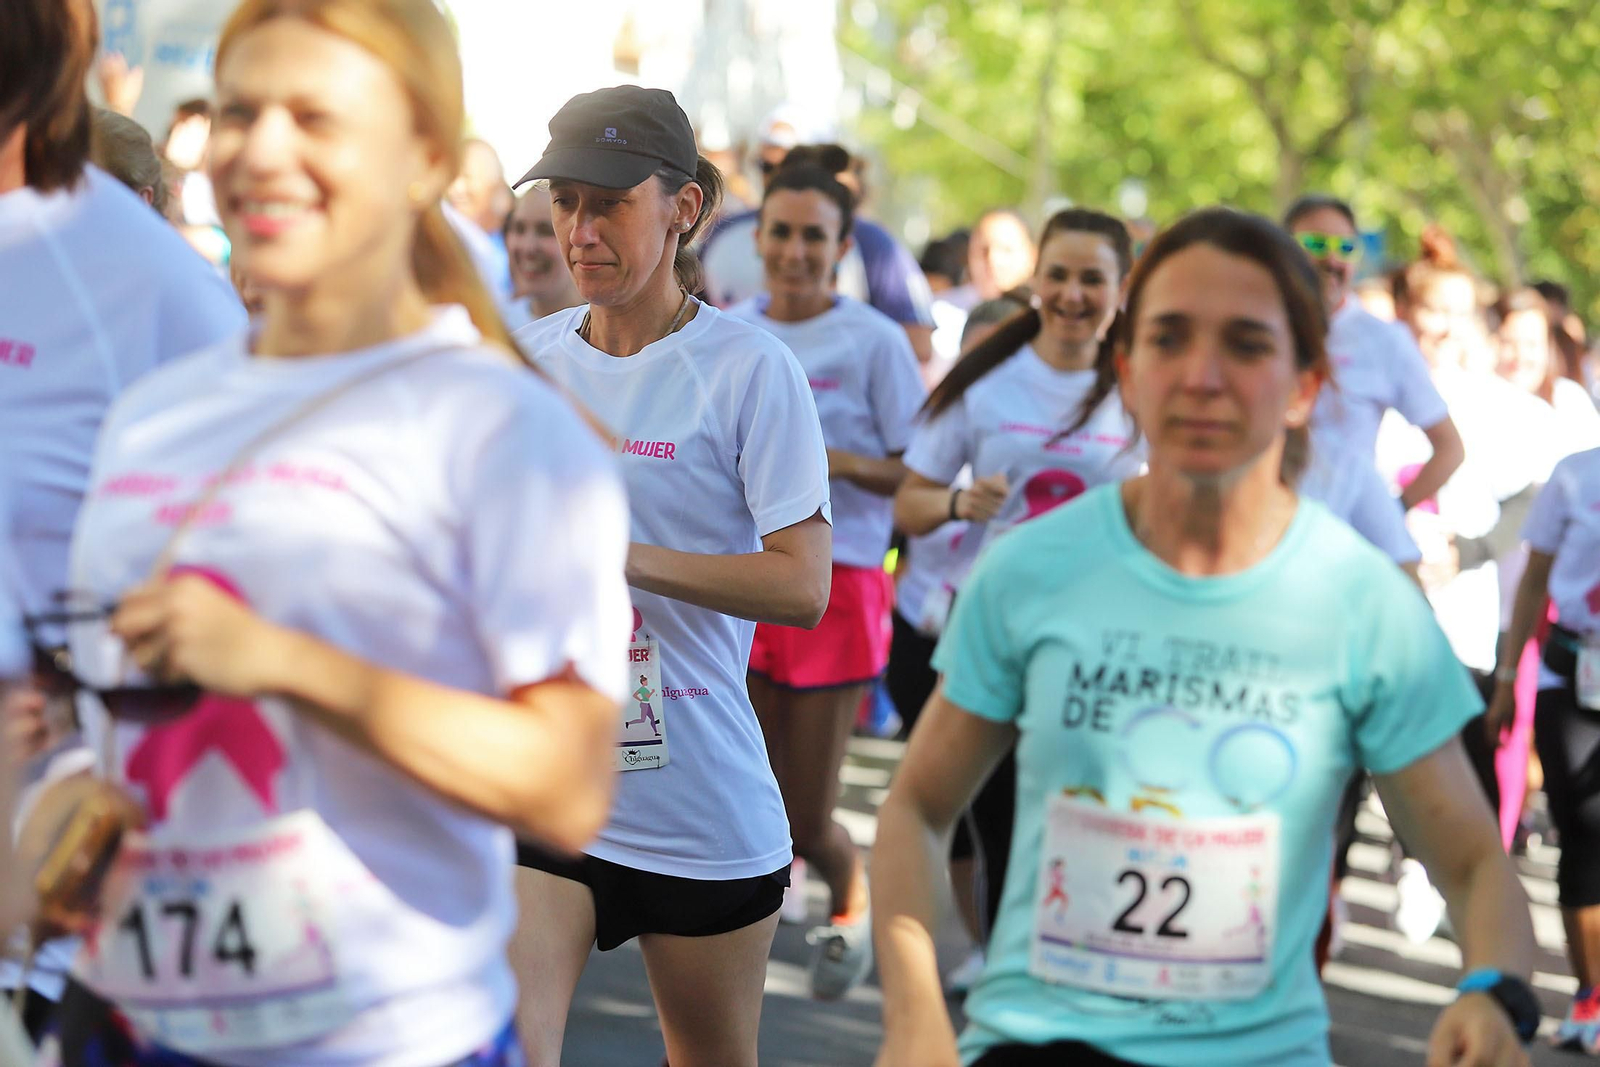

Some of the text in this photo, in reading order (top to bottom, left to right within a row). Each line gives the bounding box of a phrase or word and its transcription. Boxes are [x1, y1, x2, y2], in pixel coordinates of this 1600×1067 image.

[621, 438, 676, 461] MUJER
[628, 648, 649, 662] JER
[661, 686, 710, 700] iguagua
[1060, 691, 1116, 733] DE
[1065, 659, 1302, 726] MARISMAS
[1112, 870, 1191, 939] 22
[119, 901, 256, 979] 174
